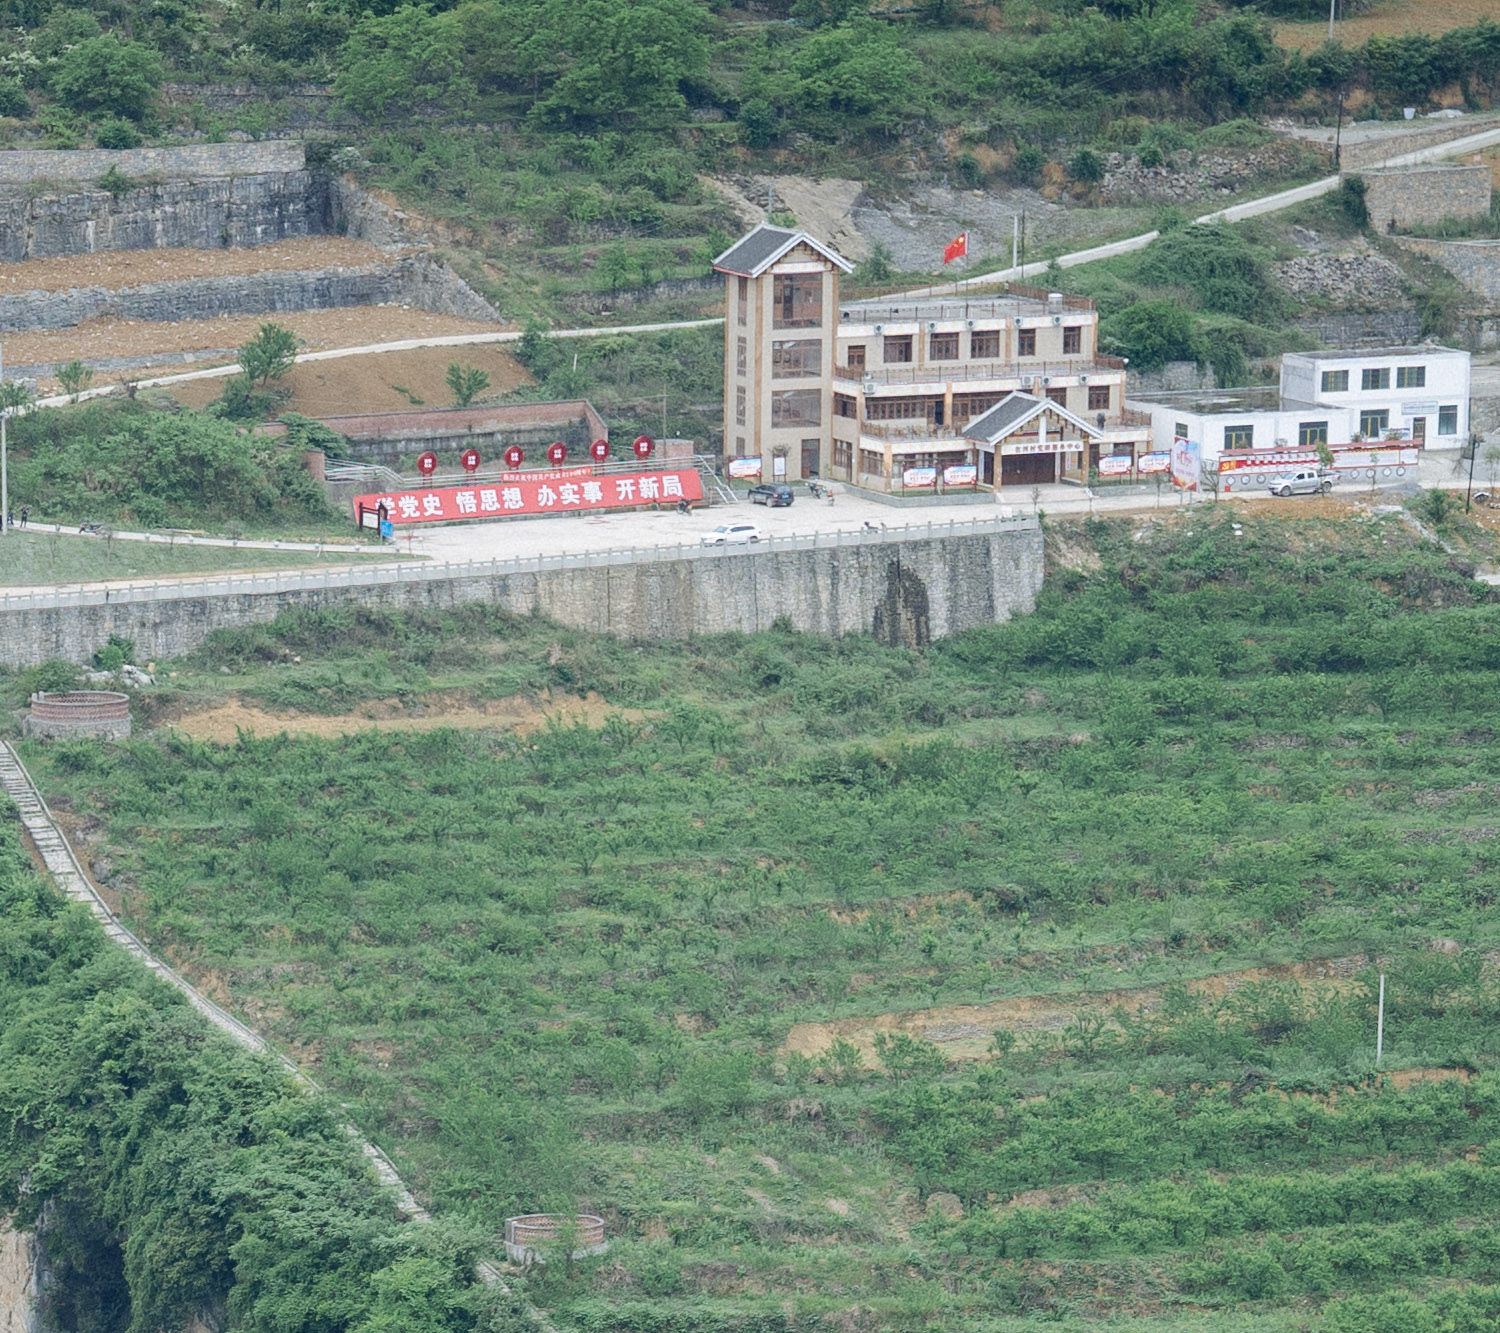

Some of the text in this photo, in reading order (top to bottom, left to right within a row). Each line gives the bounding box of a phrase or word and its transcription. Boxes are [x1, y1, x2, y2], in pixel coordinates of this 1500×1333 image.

[375, 475, 684, 519] 学党史 悟思想 办实事 开新局
